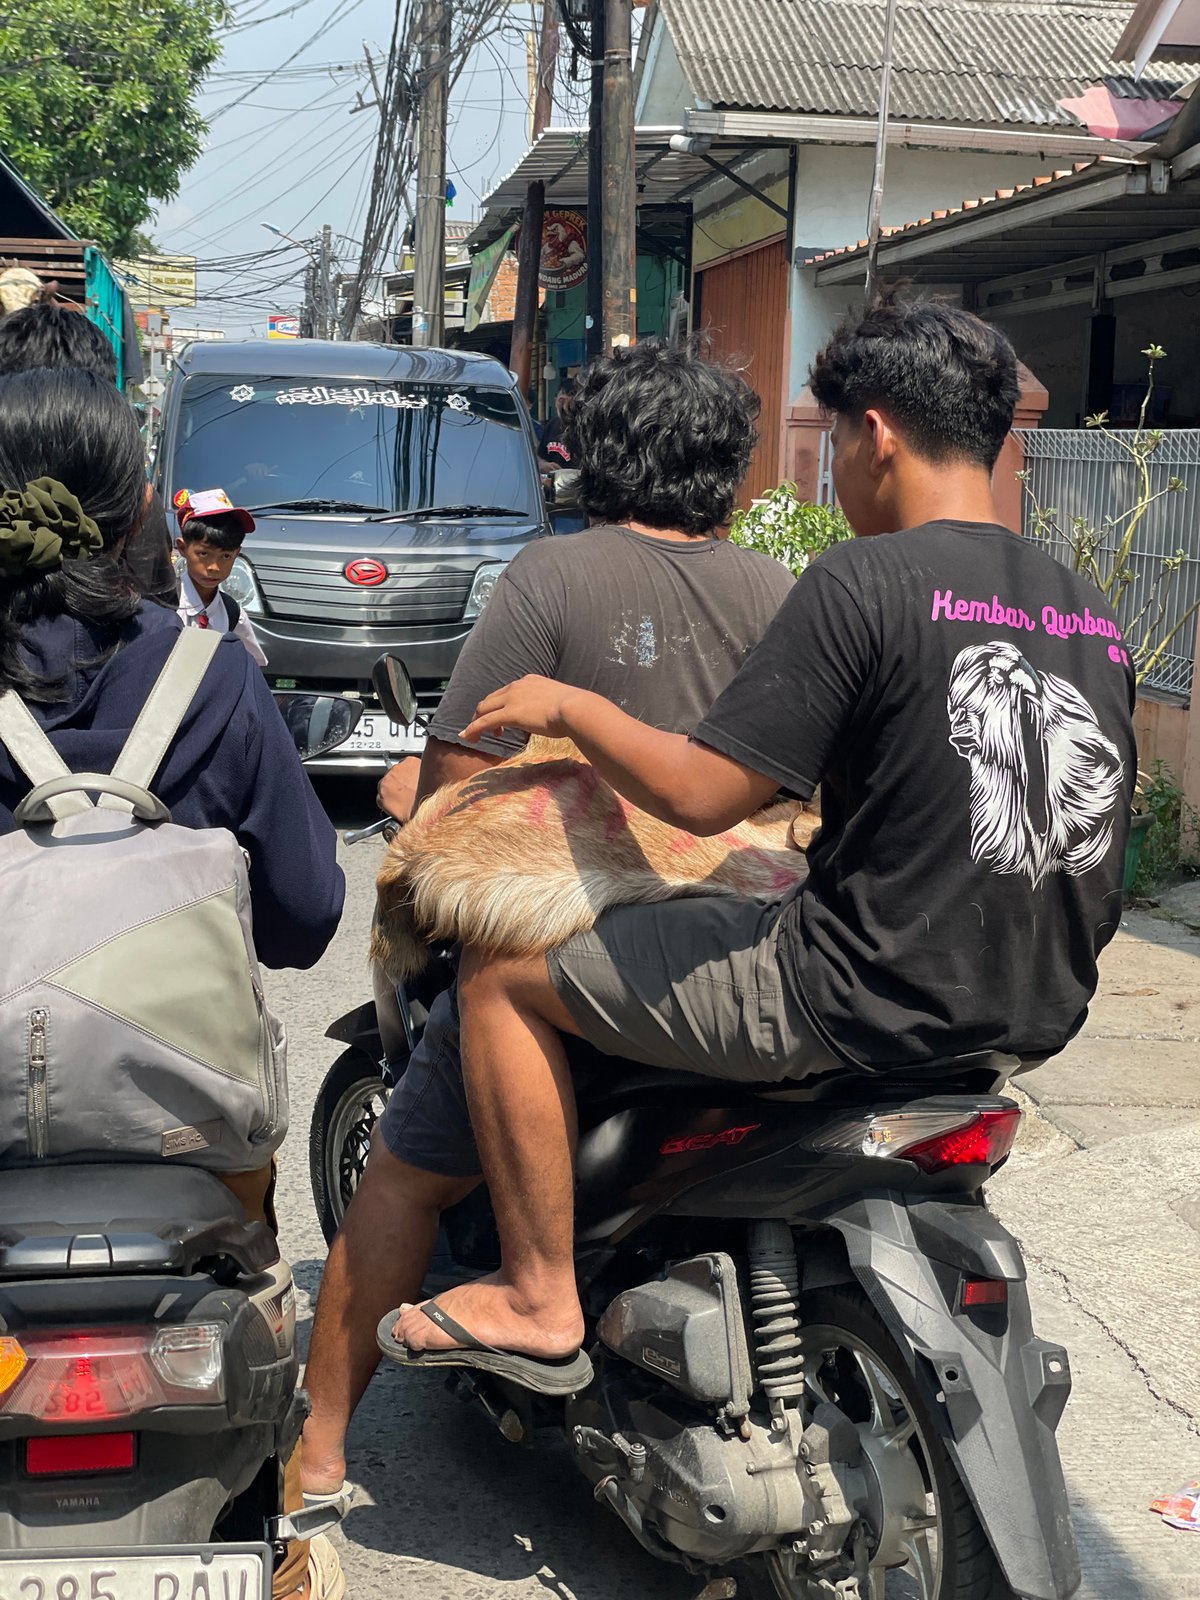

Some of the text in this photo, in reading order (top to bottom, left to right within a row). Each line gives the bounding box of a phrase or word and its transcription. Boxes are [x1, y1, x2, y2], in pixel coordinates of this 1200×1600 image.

[552, 210, 588, 230] GEPREK
[538, 273, 562, 284] NDANG
[931, 589, 1121, 640] Kembar Qurban
[353, 718, 374, 737] 45
[56, 1497, 100, 1508] YAMAHA
[19, 1570, 117, 1600] 285
